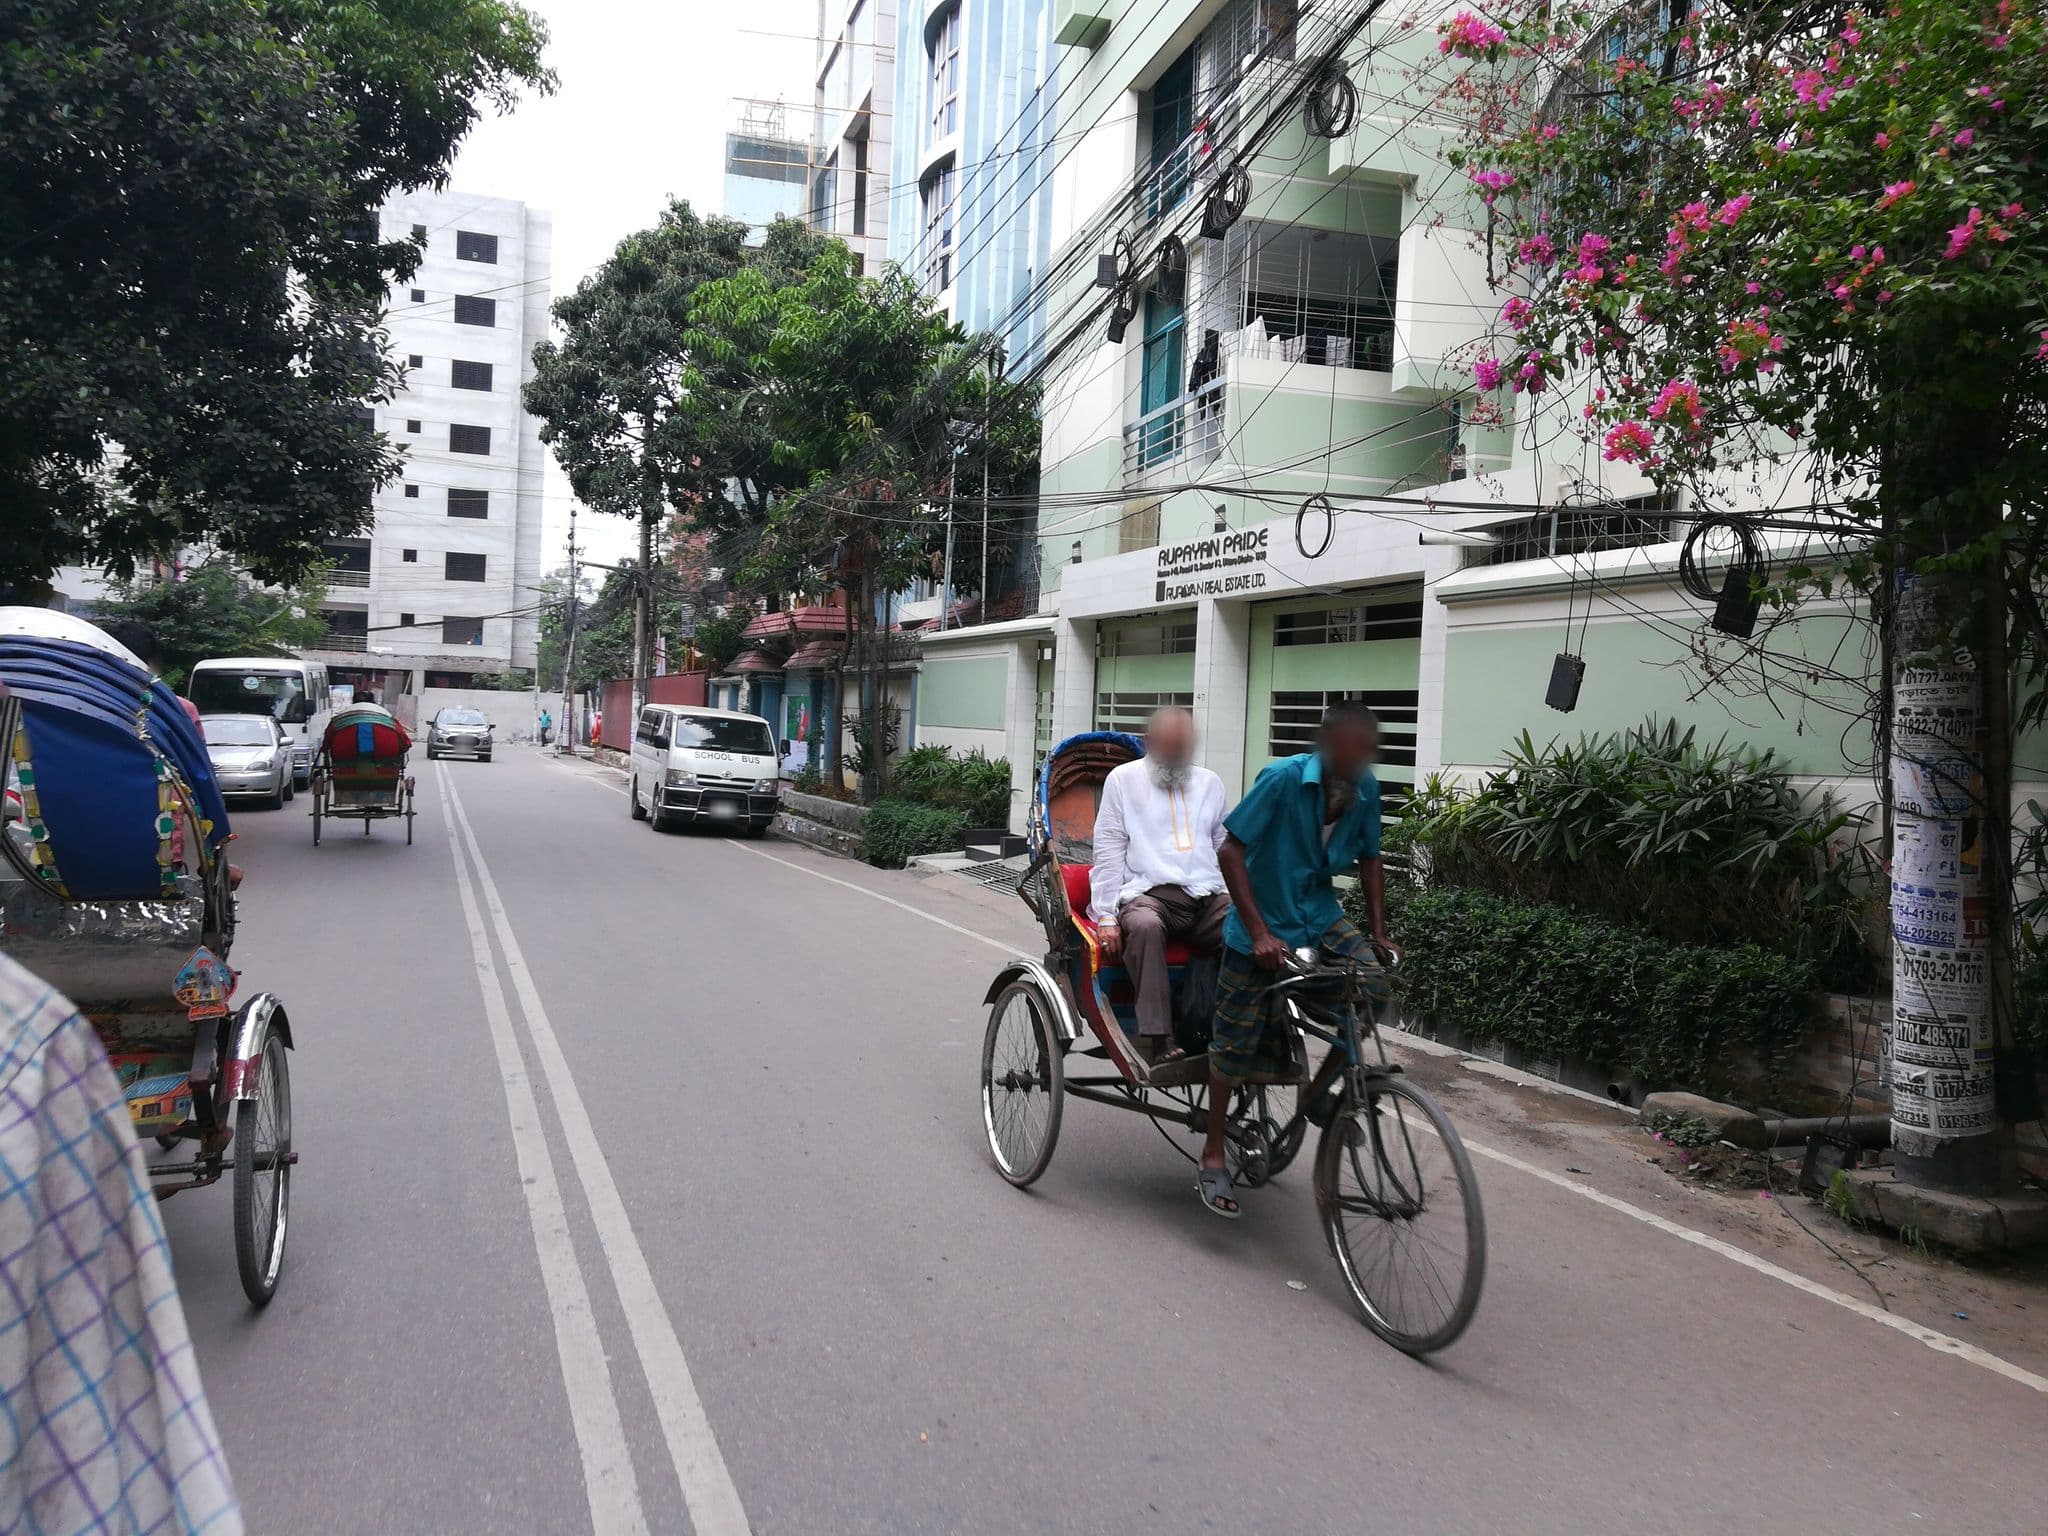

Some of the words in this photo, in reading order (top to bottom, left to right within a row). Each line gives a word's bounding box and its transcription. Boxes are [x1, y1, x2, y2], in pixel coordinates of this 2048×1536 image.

[1158, 538, 1220, 567] RUPAYAN
[1223, 528, 1268, 555] PRIDE
[1204, 579, 1223, 595] REAL
[1225, 574, 1250, 592] ESTATE
[695, 751, 733, 761] SCHOOL
[741, 755, 760, 764] BUS
